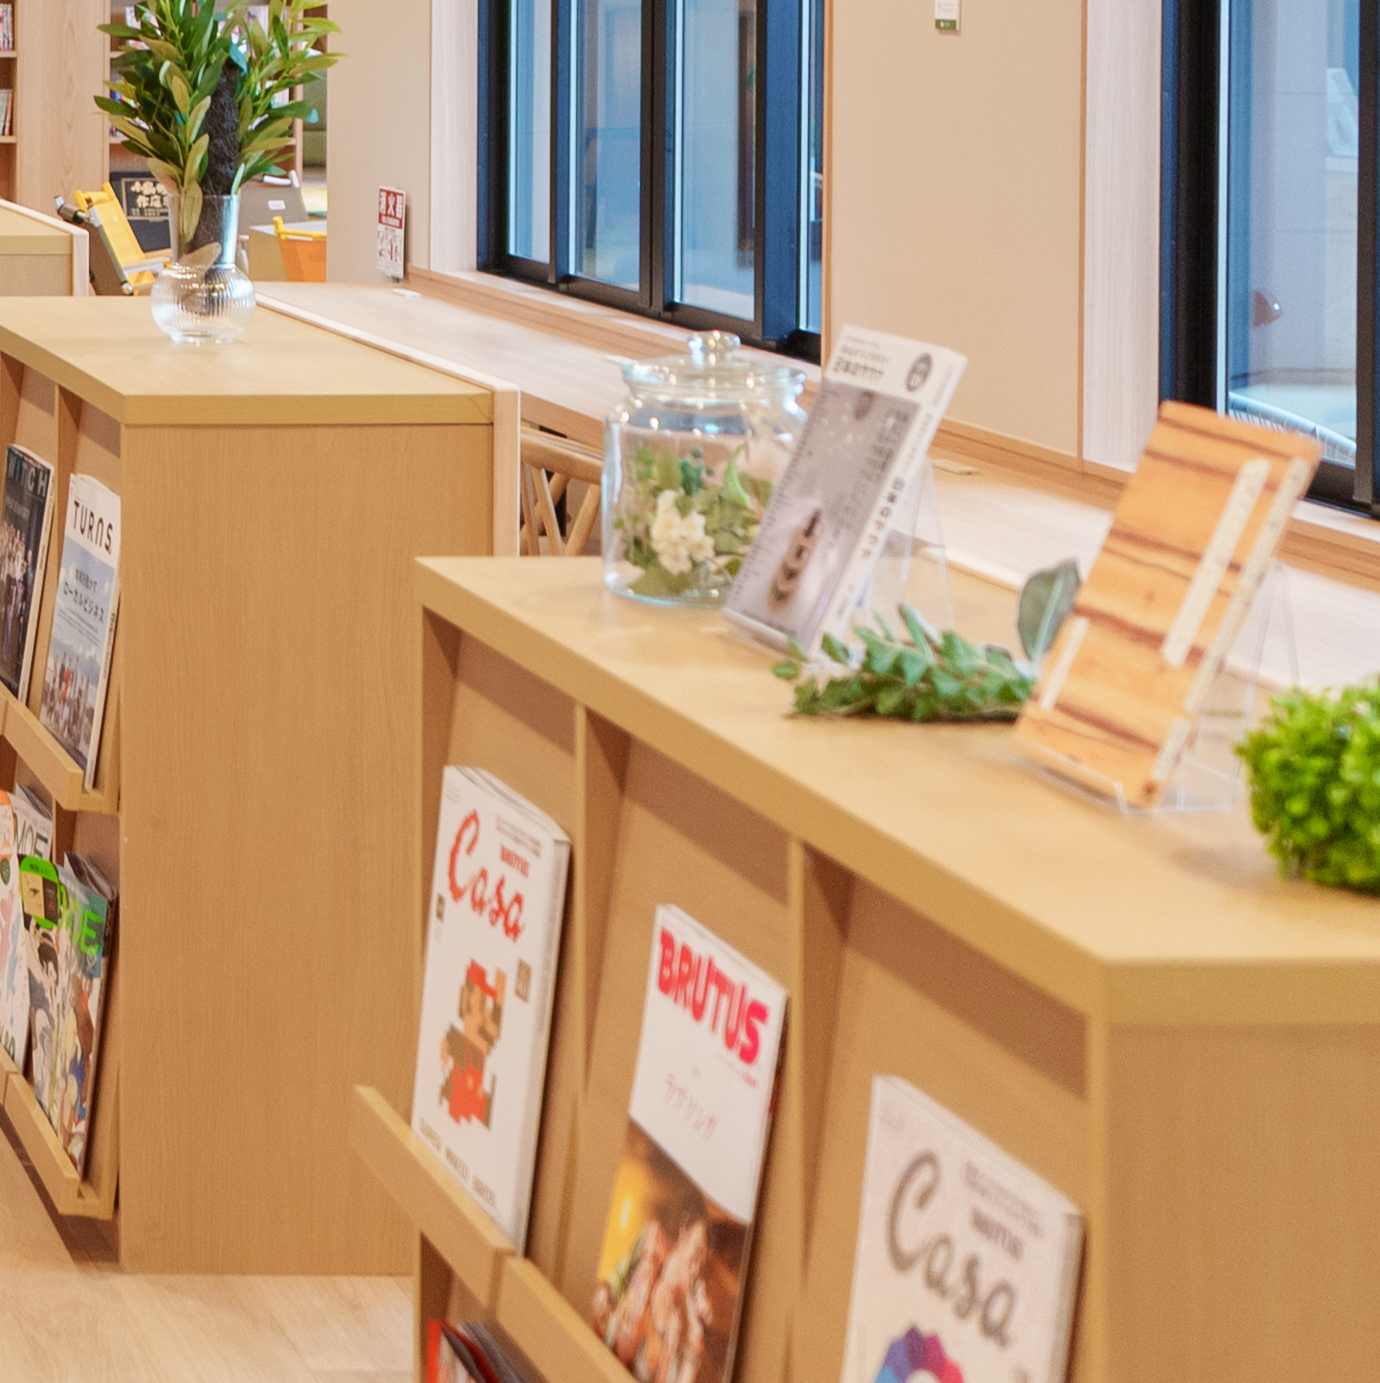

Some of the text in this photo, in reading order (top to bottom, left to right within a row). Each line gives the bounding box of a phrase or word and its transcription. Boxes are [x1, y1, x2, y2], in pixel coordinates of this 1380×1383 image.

[448, 808, 526, 944] Casa
[657, 925, 771, 1066] BRUTUS
[885, 1148, 1017, 1348] Casa
